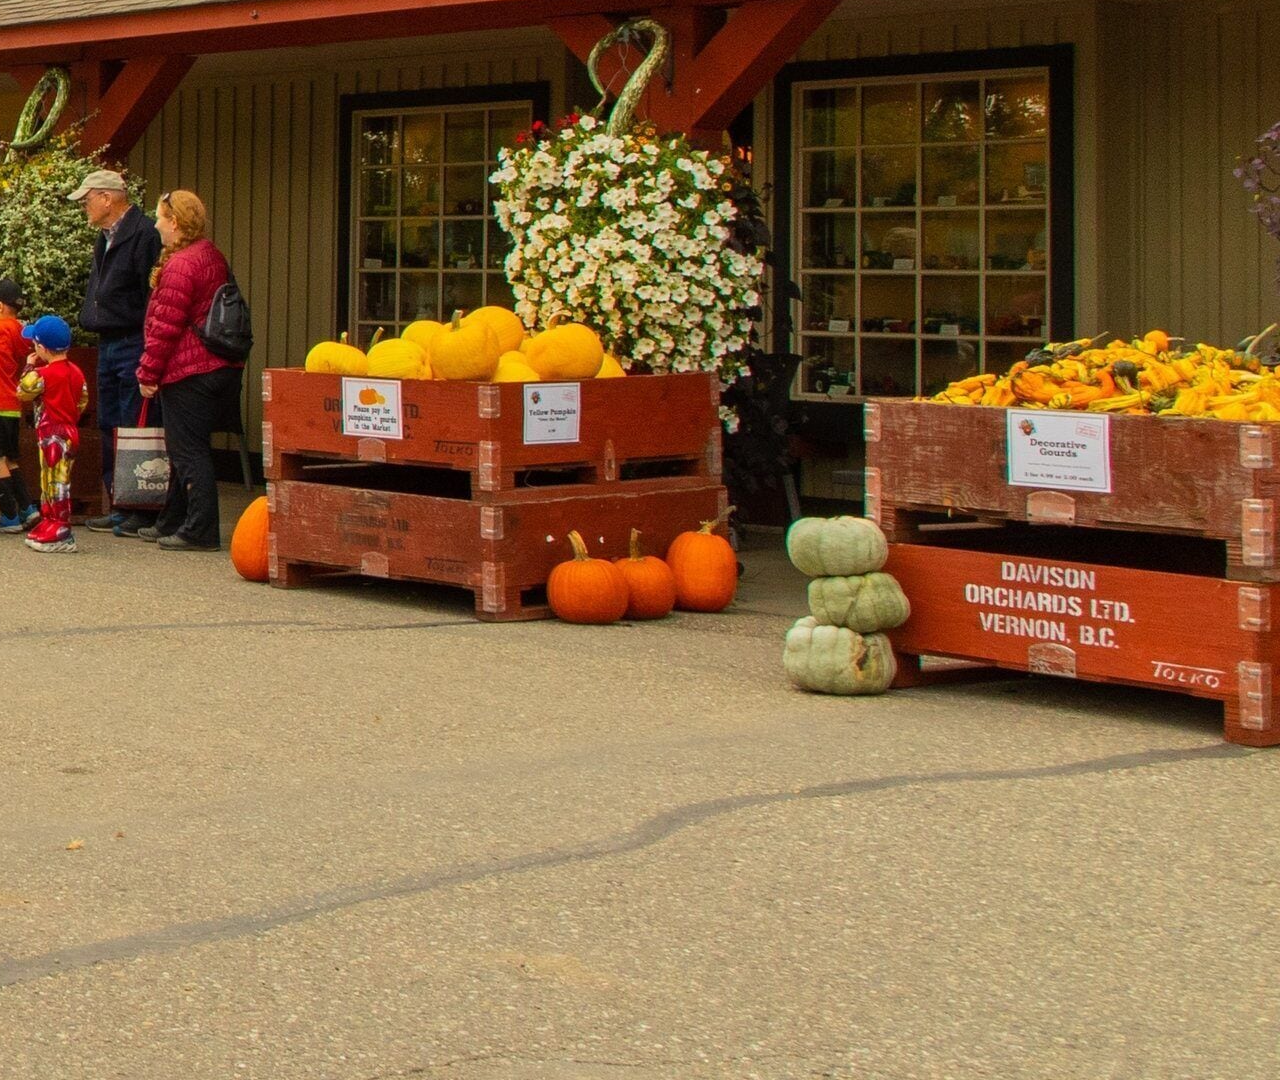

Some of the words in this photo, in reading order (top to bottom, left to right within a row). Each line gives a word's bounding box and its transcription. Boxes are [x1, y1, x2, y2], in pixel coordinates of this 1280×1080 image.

[353, 404, 369, 413] Please
[372, 406, 380, 414] pay
[383, 406, 391, 414] for
[550, 408, 576, 416] Pumpkin
[348, 413, 372, 422] pumpkins
[434, 440, 479, 456] TOLKO
[1030, 438, 1087, 450] Decorative
[1039, 448, 1078, 458] Gourds
[1001, 561, 1096, 591] DAVISON
[964, 583, 1083, 618] ORCHARDS
[1090, 598, 1136, 624] LTD.
[979, 611, 1072, 645] VERNON,
[1079, 625, 1120, 649] B.C.
[1151, 660, 1227, 689] TOLKO
